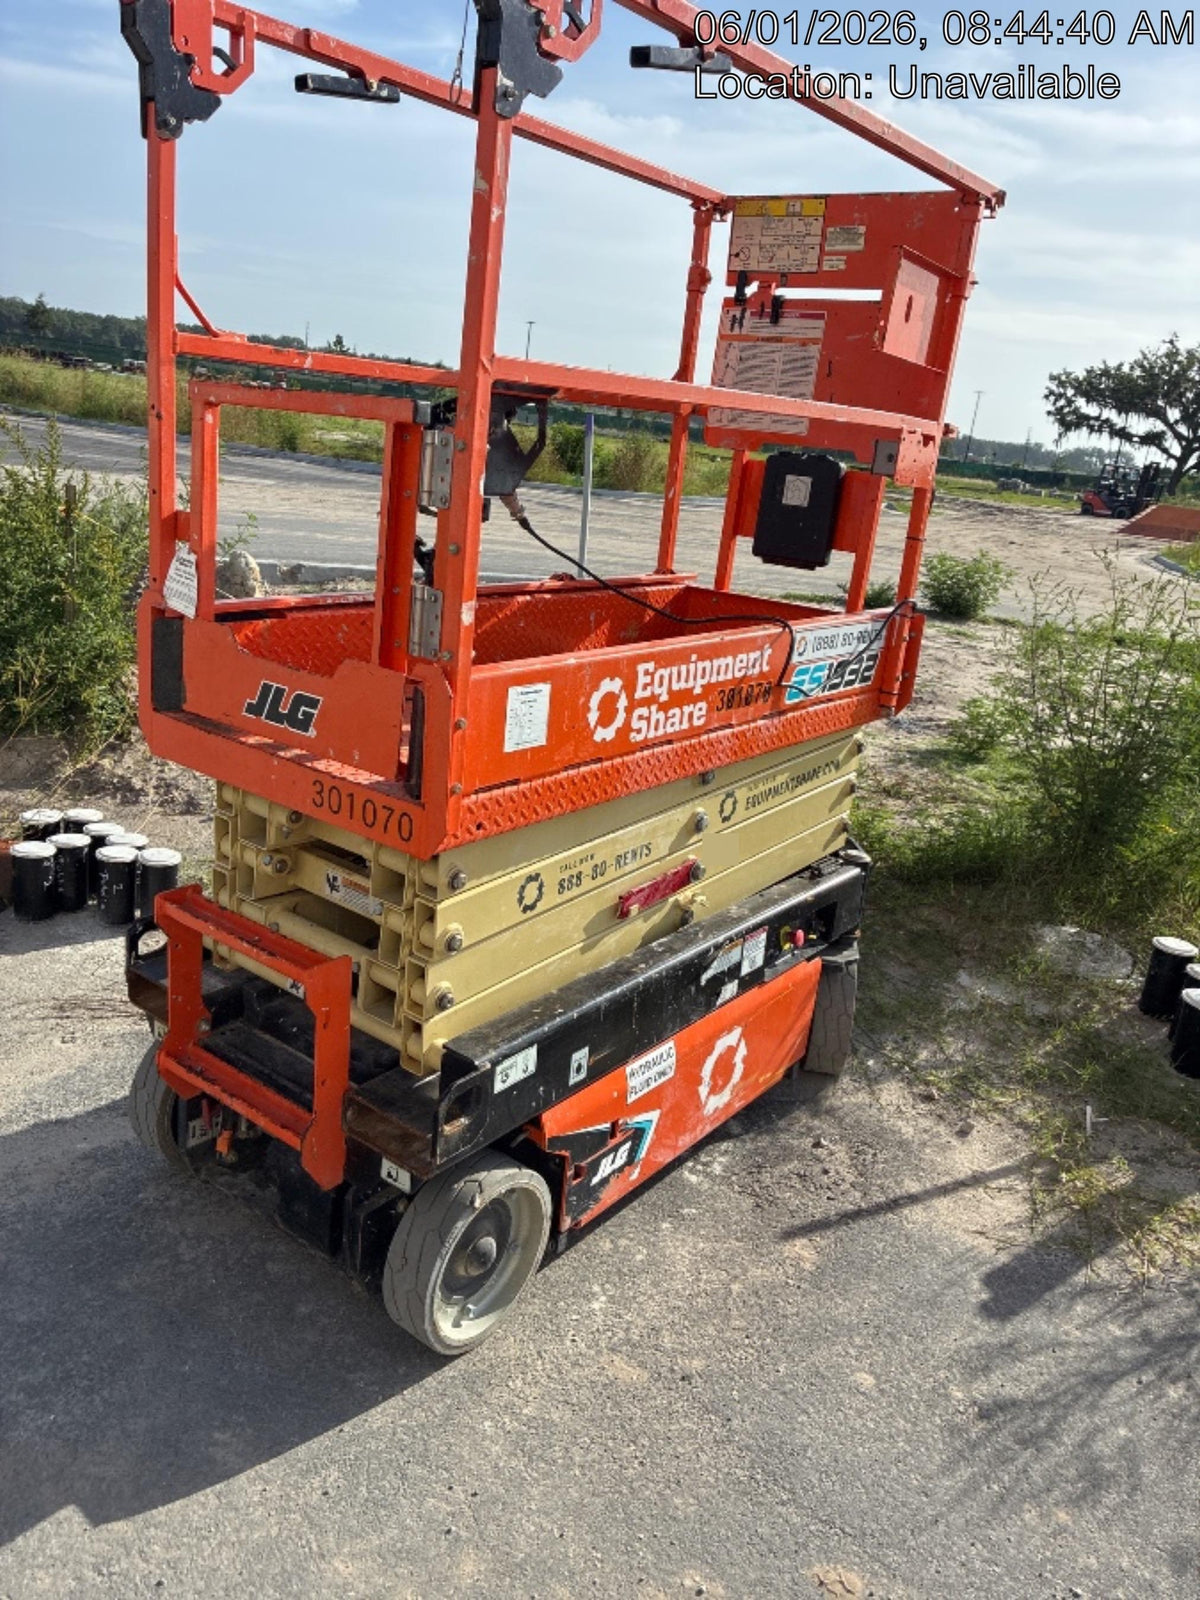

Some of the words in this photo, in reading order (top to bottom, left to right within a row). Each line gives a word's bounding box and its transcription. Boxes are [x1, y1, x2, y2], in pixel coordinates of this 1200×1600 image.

[634, 643, 773, 703] Equipment
[242, 680, 324, 737] JLG
[629, 700, 708, 743] Share
[311, 779, 414, 843] 301070
[557, 842, 652, 895] 888-80-RENTS
[590, 1140, 633, 1187] JLG
